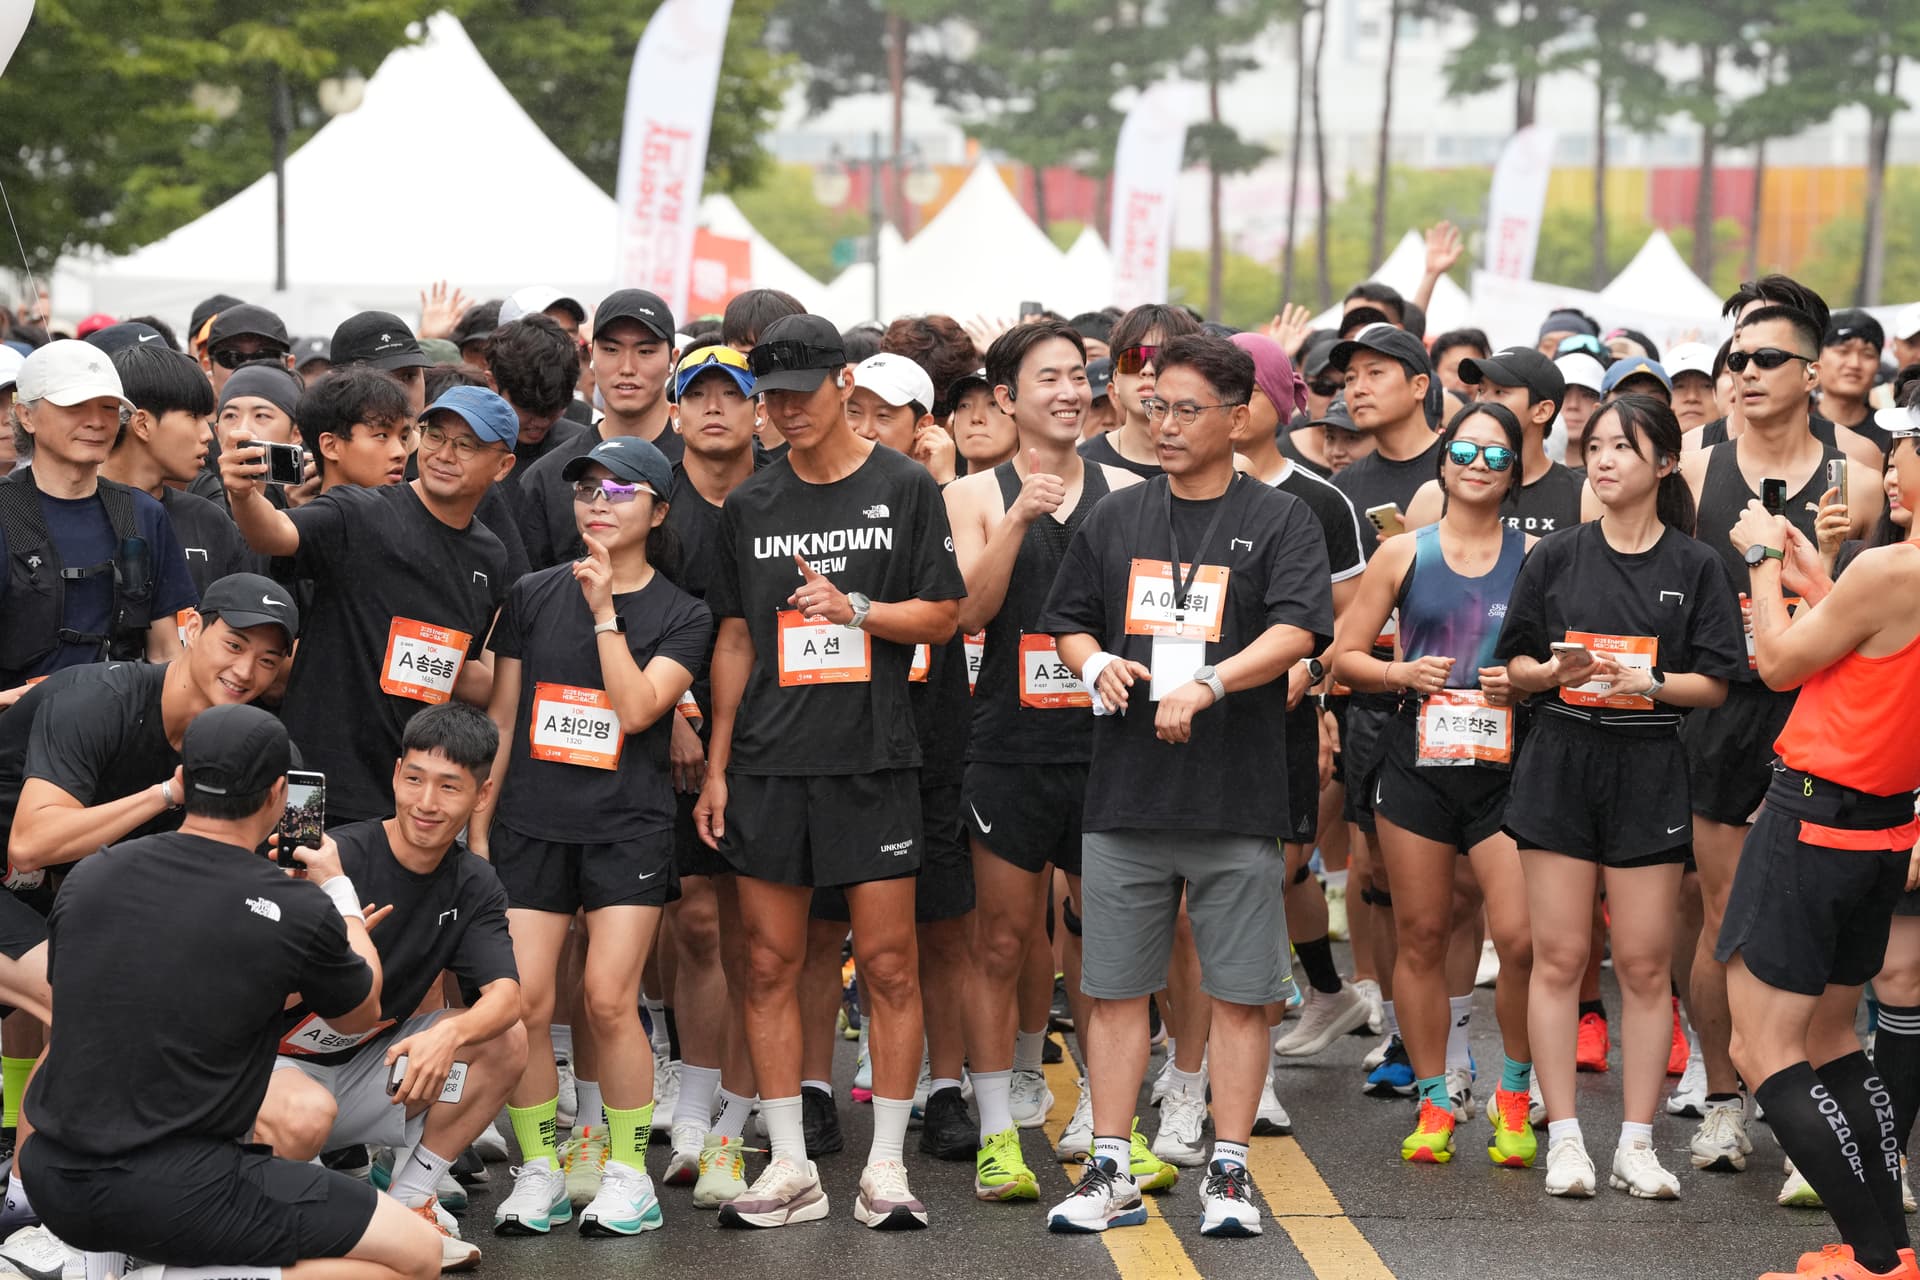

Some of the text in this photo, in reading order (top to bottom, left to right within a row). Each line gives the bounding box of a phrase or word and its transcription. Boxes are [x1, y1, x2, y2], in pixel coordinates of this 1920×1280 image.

[754, 527, 893, 559] UNKNOWN
[1140, 590, 1155, 606] A
[803, 636, 840, 656] A 션
[399, 651, 455, 679] A 송승종
[1035, 664, 1049, 680] A
[544, 715, 610, 740] A 최인영
[1435, 716, 1497, 736] A 정찬주
[303, 1029, 321, 1041] A
[1810, 1084, 1865, 1183] COMPORT
[1863, 1076, 1899, 1181] COMPORT
